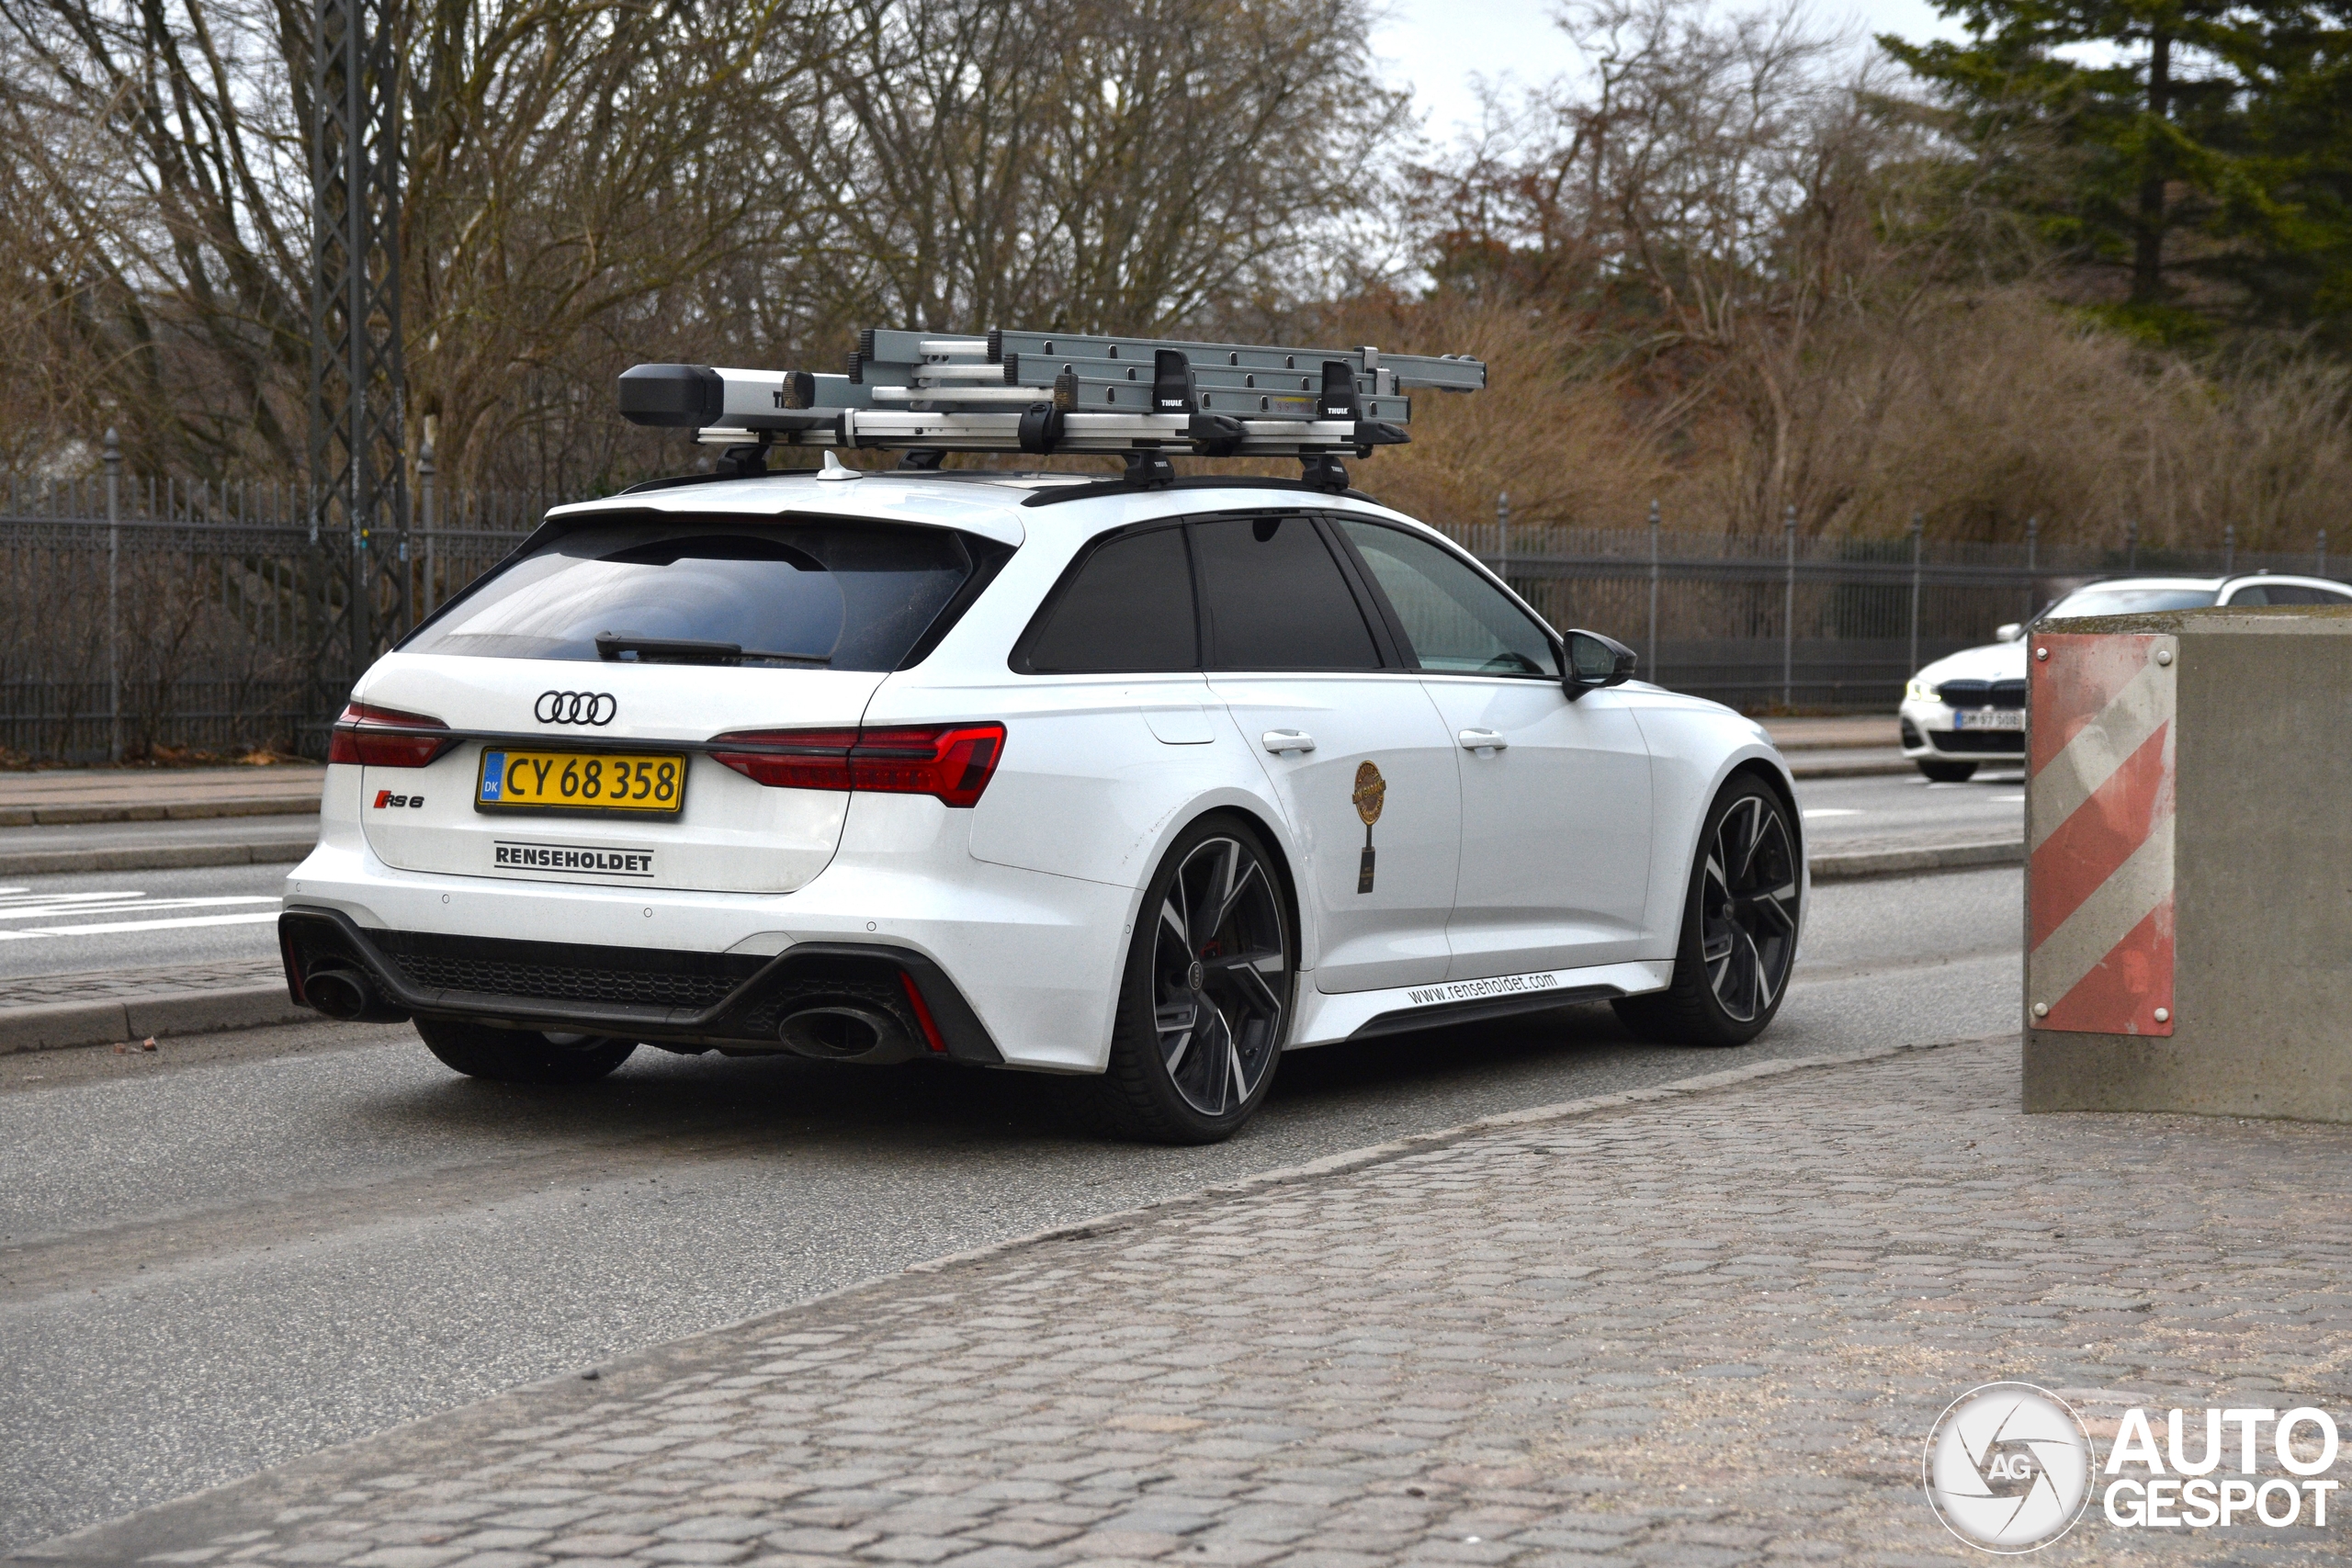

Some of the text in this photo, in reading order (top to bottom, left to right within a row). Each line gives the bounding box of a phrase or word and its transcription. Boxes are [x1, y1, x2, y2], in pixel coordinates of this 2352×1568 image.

[1161, 399, 1183, 407] THULE
[484, 781, 498, 793] DK
[506, 758, 676, 801] CY 68 358
[495, 847, 652, 871] RENSEHOLDET
[1408, 972, 1558, 1005] www.renseholdet.com
